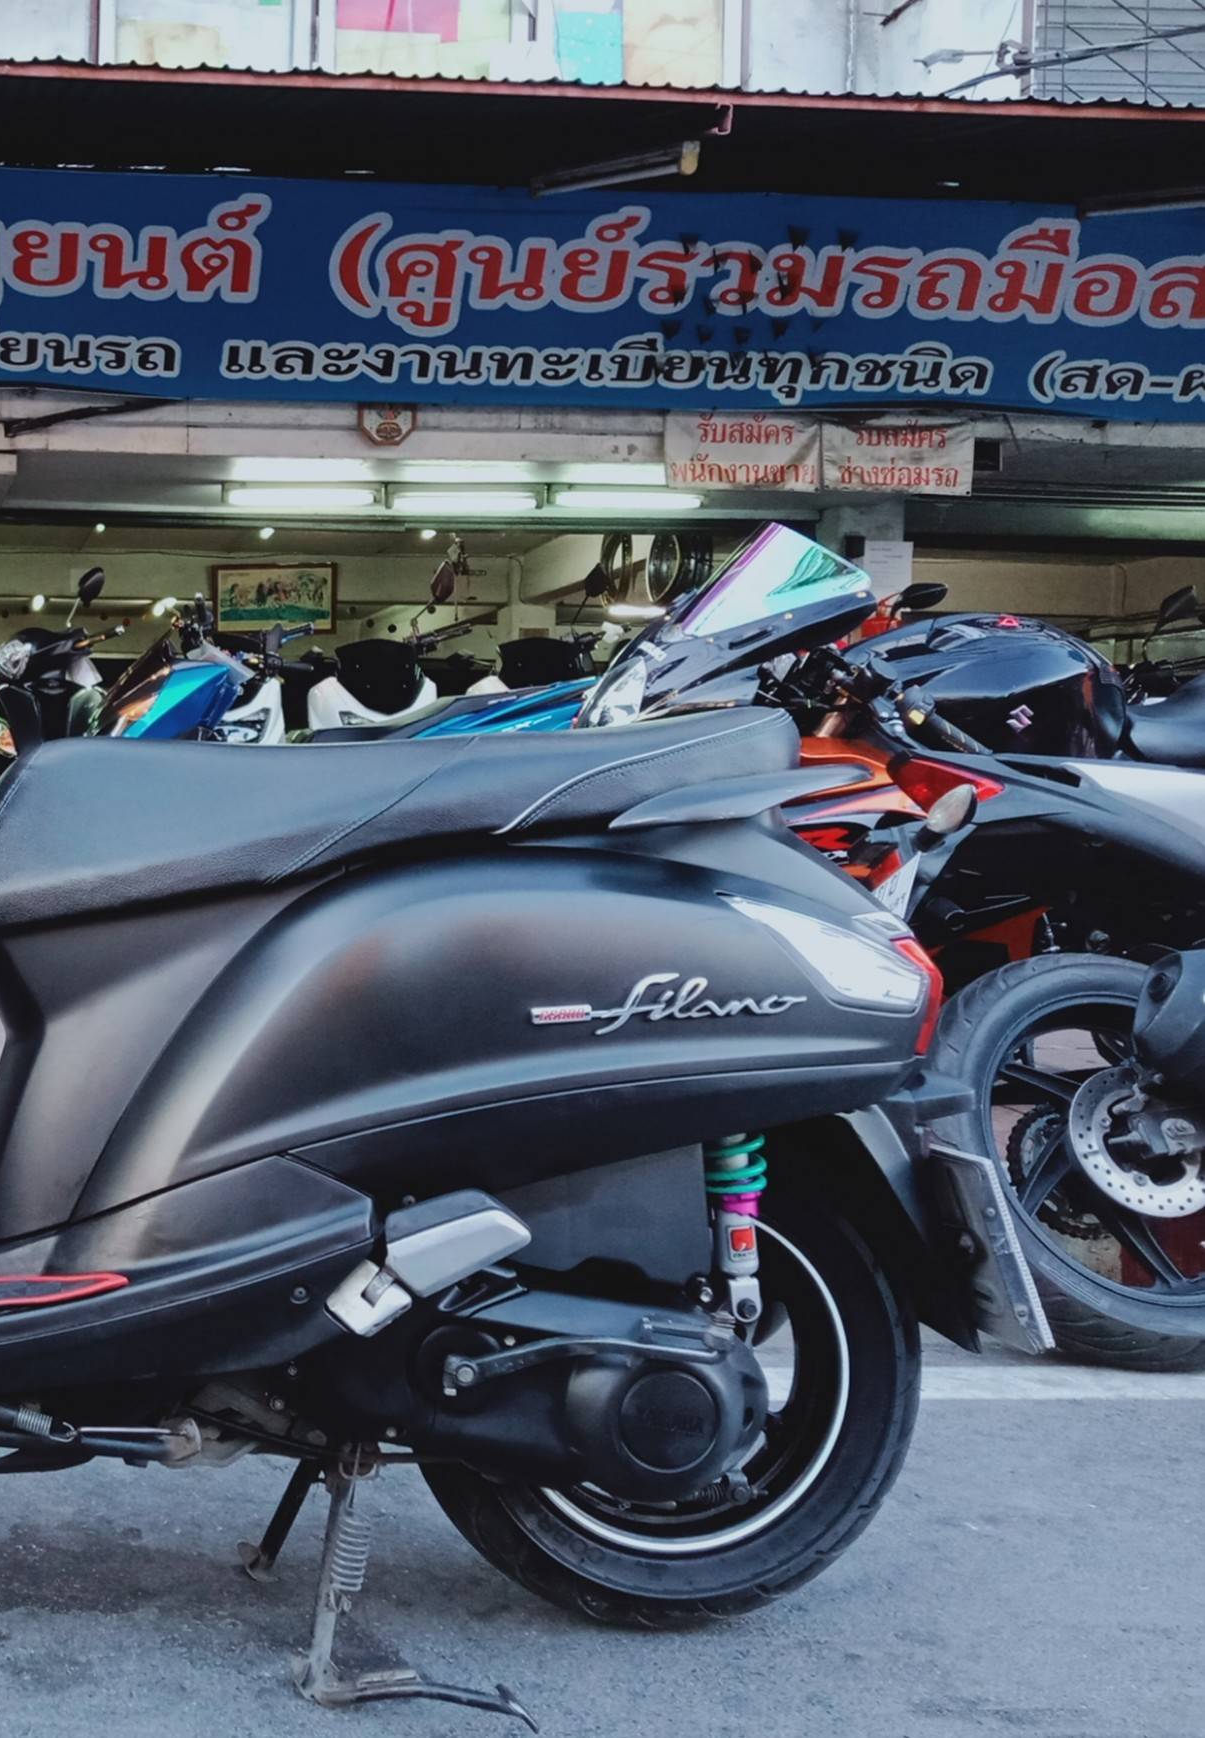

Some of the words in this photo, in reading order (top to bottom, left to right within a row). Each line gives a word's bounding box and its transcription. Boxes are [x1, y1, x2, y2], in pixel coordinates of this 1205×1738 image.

[852, 419, 949, 449] รบสมัคร
[591, 972, 808, 1036] Filano
